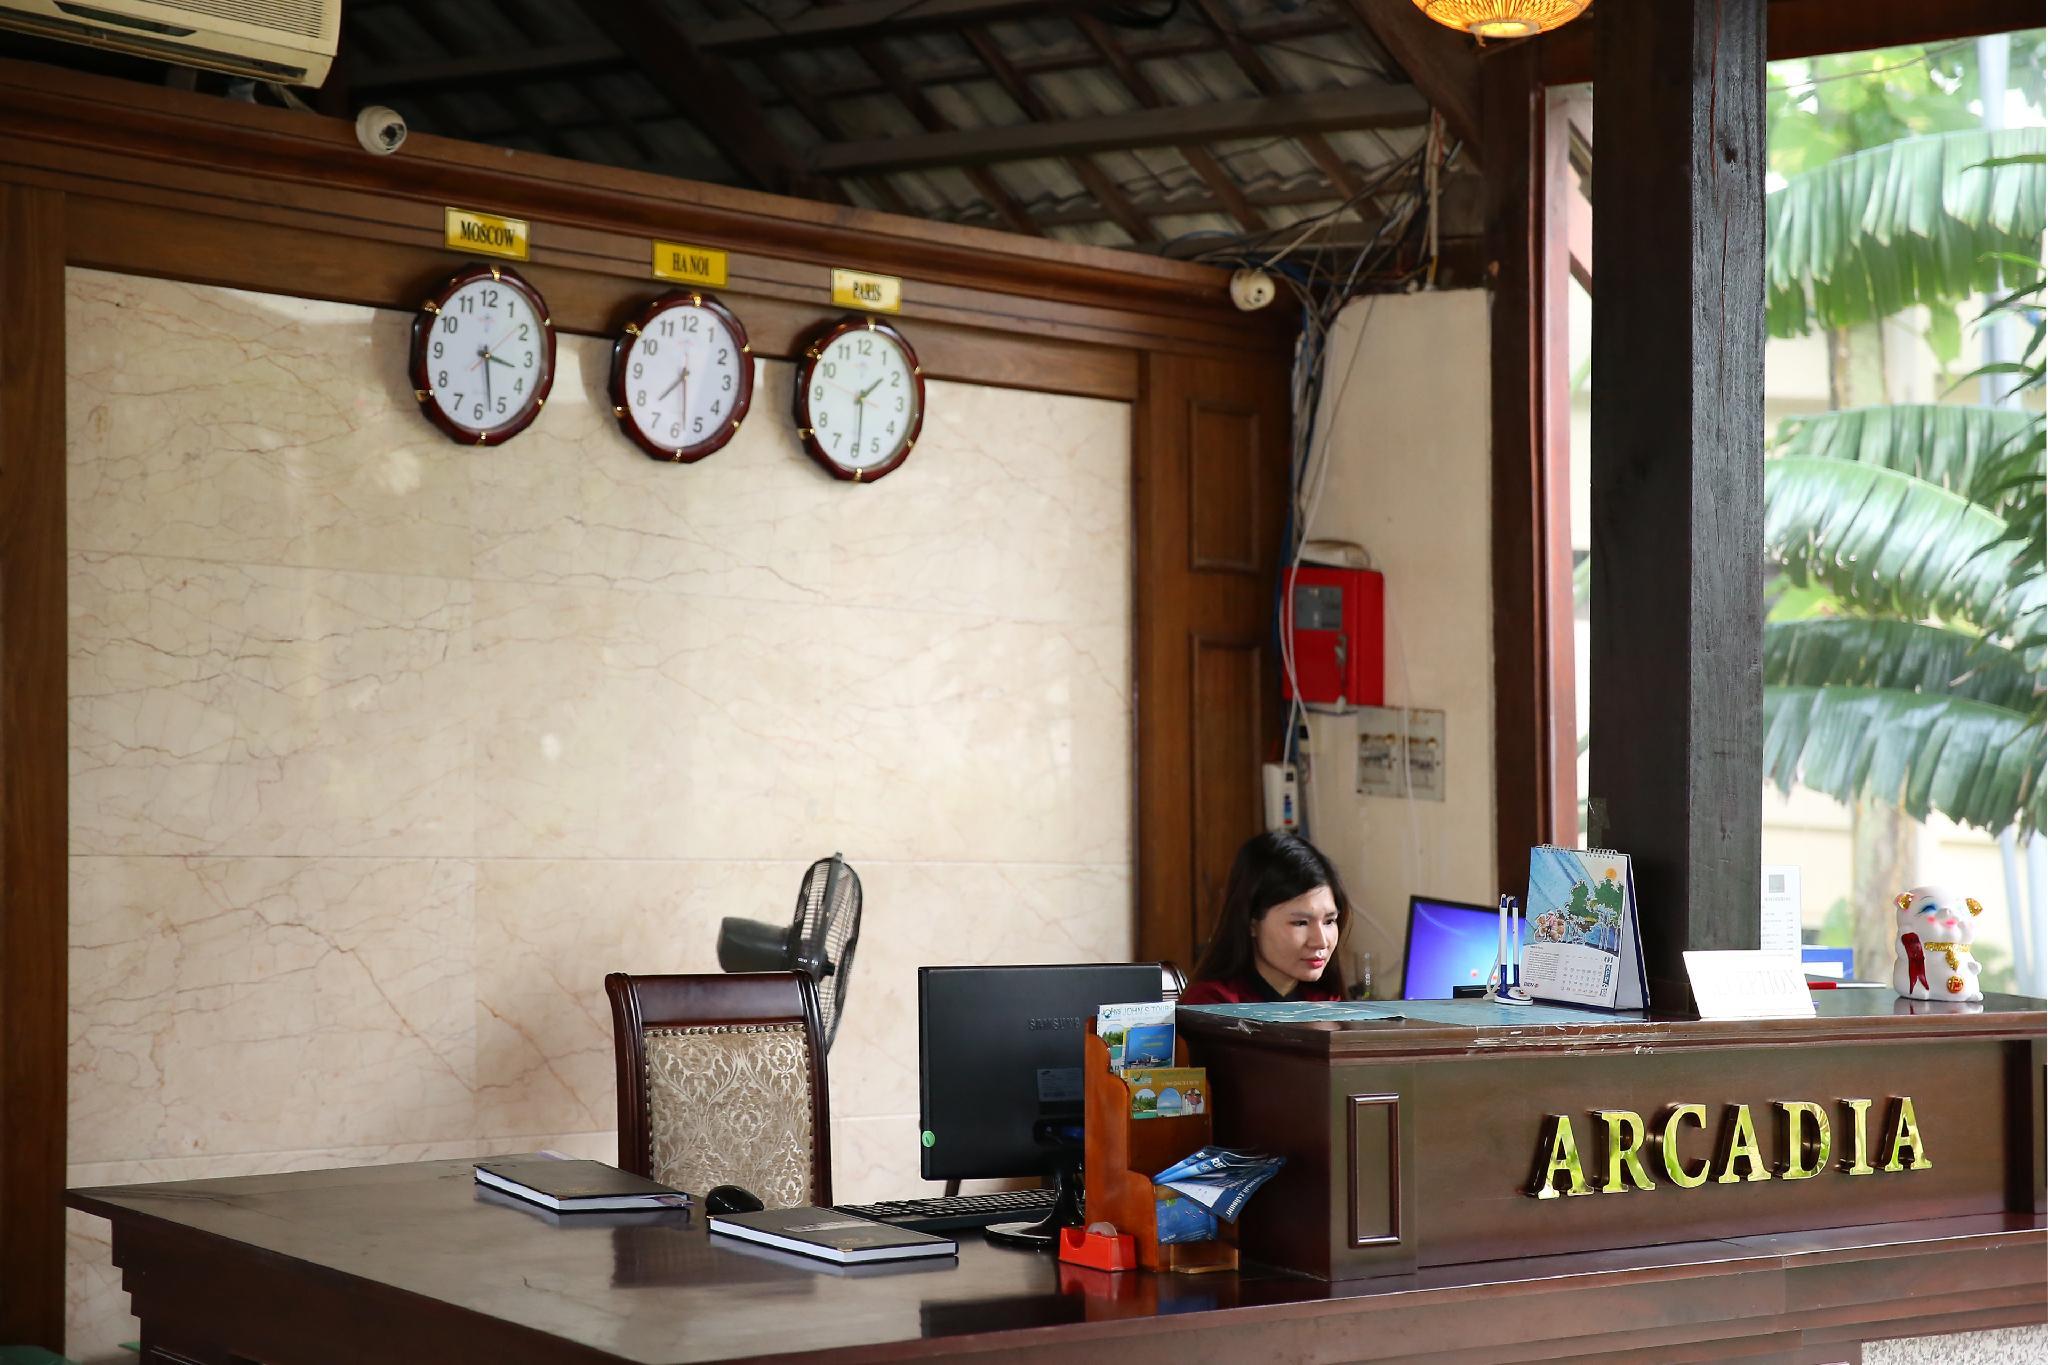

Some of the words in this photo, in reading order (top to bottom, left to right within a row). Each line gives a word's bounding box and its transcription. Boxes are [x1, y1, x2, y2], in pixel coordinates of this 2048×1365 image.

[461, 220, 515, 248] MOSCOW
[480, 290, 498, 308] 12
[853, 282, 881, 301] PARIS
[460, 296, 473, 314] 11
[507, 301, 514, 318] 1
[442, 316, 457, 334] 10
[660, 320, 674, 337] 11
[682, 316, 699, 332] 12
[519, 324, 528, 341] 2
[708, 327, 714, 343] 1
[433, 342, 443, 359] 9
[642, 339, 658, 355] 10
[838, 344, 850, 360] 11
[858, 340, 872, 356] 12
[523, 352, 533, 368] 3
[718, 349, 727, 365] 2
[881, 351, 887, 365] 1
[633, 363, 643, 379] 9
[822, 363, 836, 378] 10
[438, 371, 448, 387] 8
[513, 378, 523, 394] 4
[722, 375, 731, 390] 3
[891, 372, 900, 387] 2
[637, 390, 646, 406] 8
[815, 386, 823, 401] 9
[454, 393, 463, 411] 7
[496, 397, 506, 414] 5
[710, 399, 720, 415] 4
[896, 397, 903, 412] 3
[474, 403, 484, 420] 6
[651, 412, 661, 428] 7
[693, 417, 703, 433] 5
[819, 412, 827, 428] 8
[886, 421, 895, 435] 4
[670, 422, 679, 438] 6
[833, 433, 842, 448] 7
[871, 438, 880, 453] 5
[851, 443, 859, 458] 6
[1536, 1096, 1933, 1200] ARCADIA
